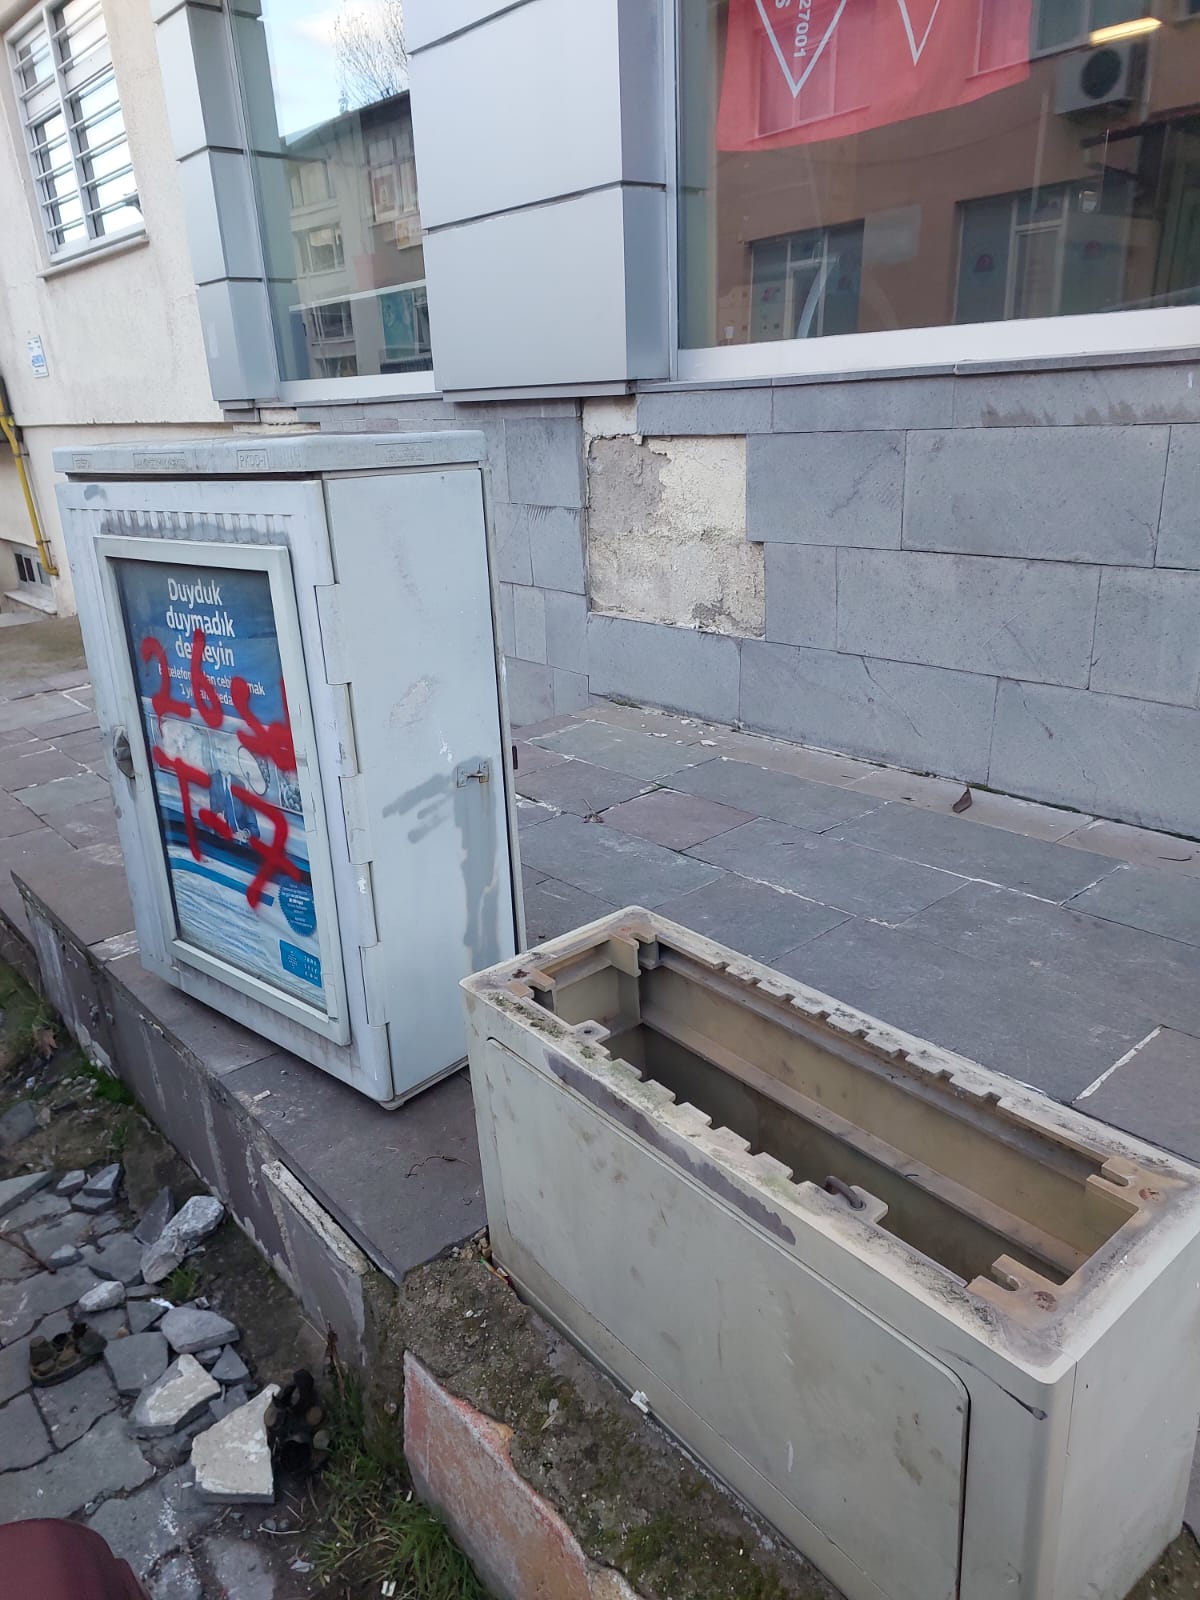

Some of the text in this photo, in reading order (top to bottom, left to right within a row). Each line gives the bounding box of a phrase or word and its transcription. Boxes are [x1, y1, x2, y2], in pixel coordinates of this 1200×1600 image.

[793, 0, 812, 58] 27001
[167, 578, 223, 609] Duyduk
[166, 604, 236, 638] duymadık
[175, 635, 235, 671] deeyin
